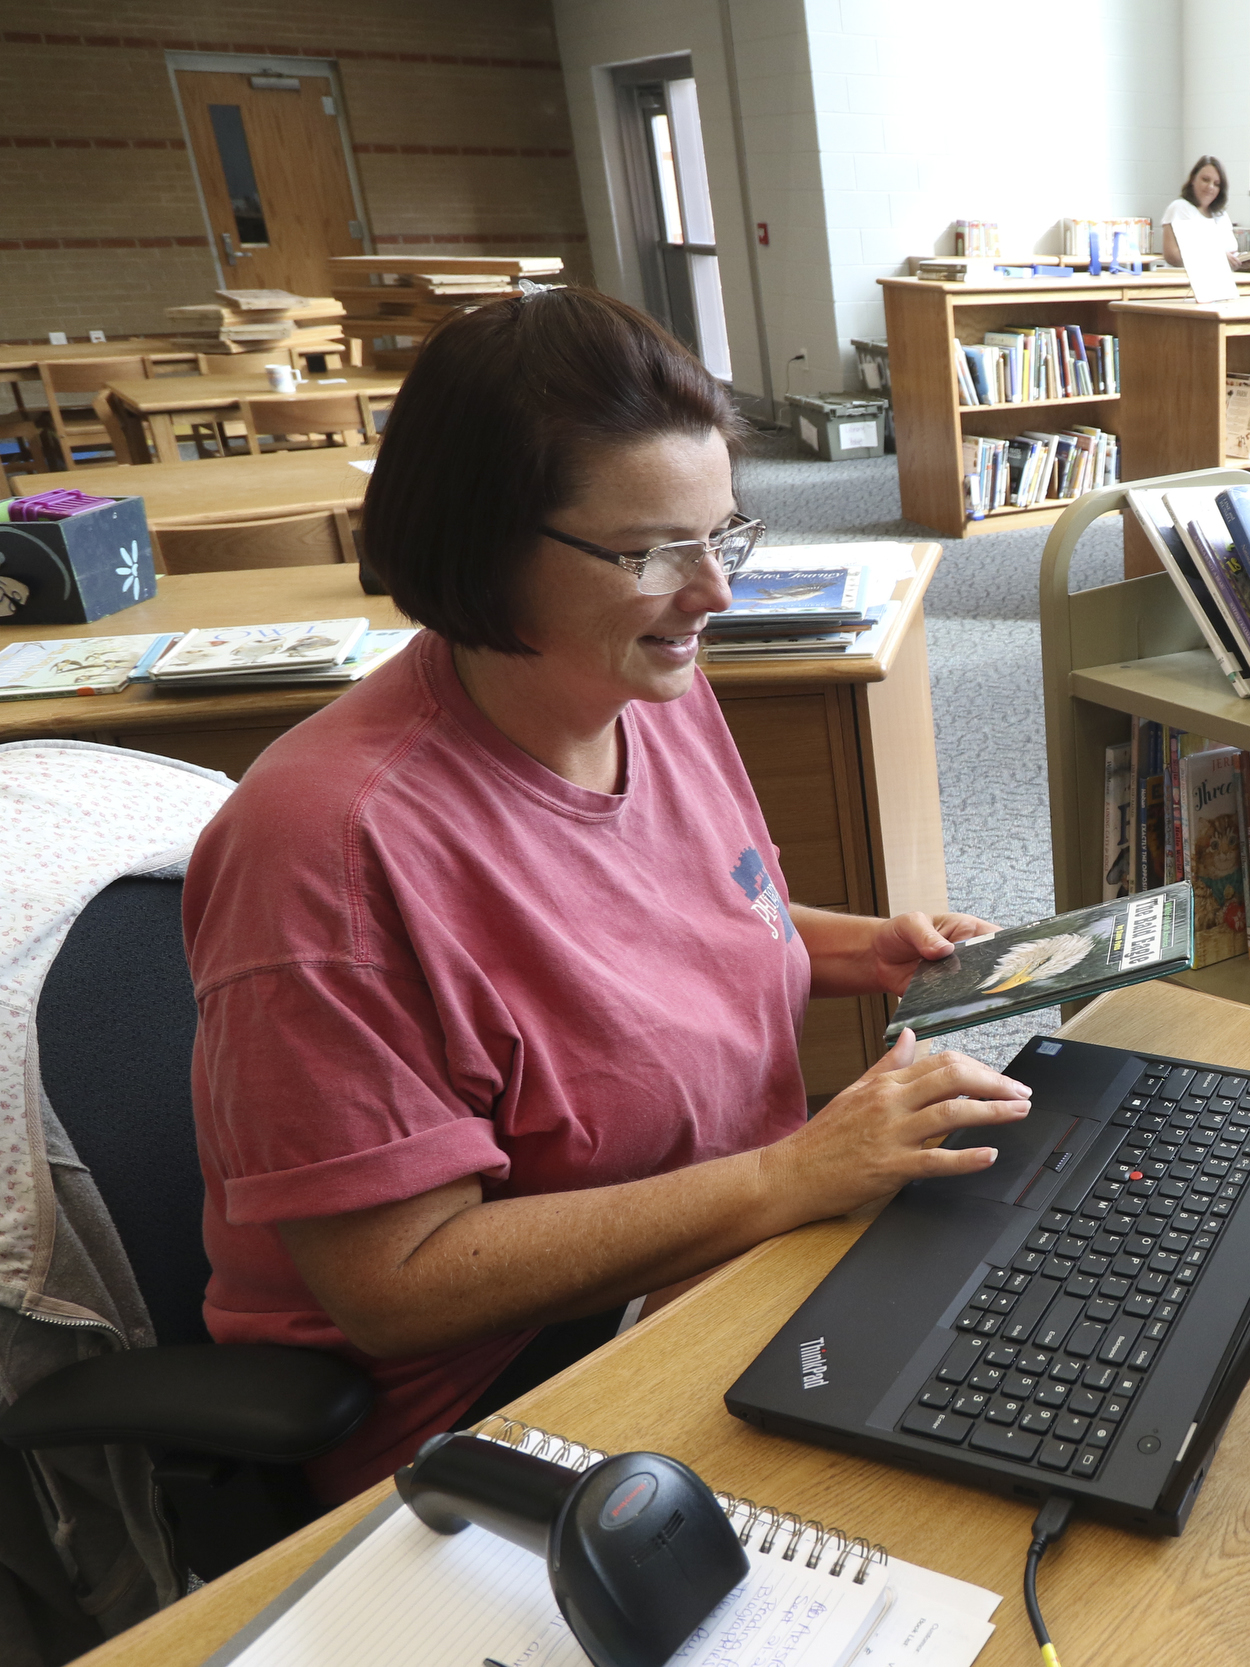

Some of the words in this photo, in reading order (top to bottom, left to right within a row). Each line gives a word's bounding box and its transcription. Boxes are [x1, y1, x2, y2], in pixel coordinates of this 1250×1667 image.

[1134, 898, 1159, 918] The
[1132, 915, 1158, 939] Bald
[1124, 937, 1156, 965] Eagle
[1011, 1325, 1023, 1336] Shift
[1044, 1330, 1056, 1344] Enter
[1108, 1335, 1125, 1358] Backspace
[799, 1336, 830, 1390] ThinkPad
